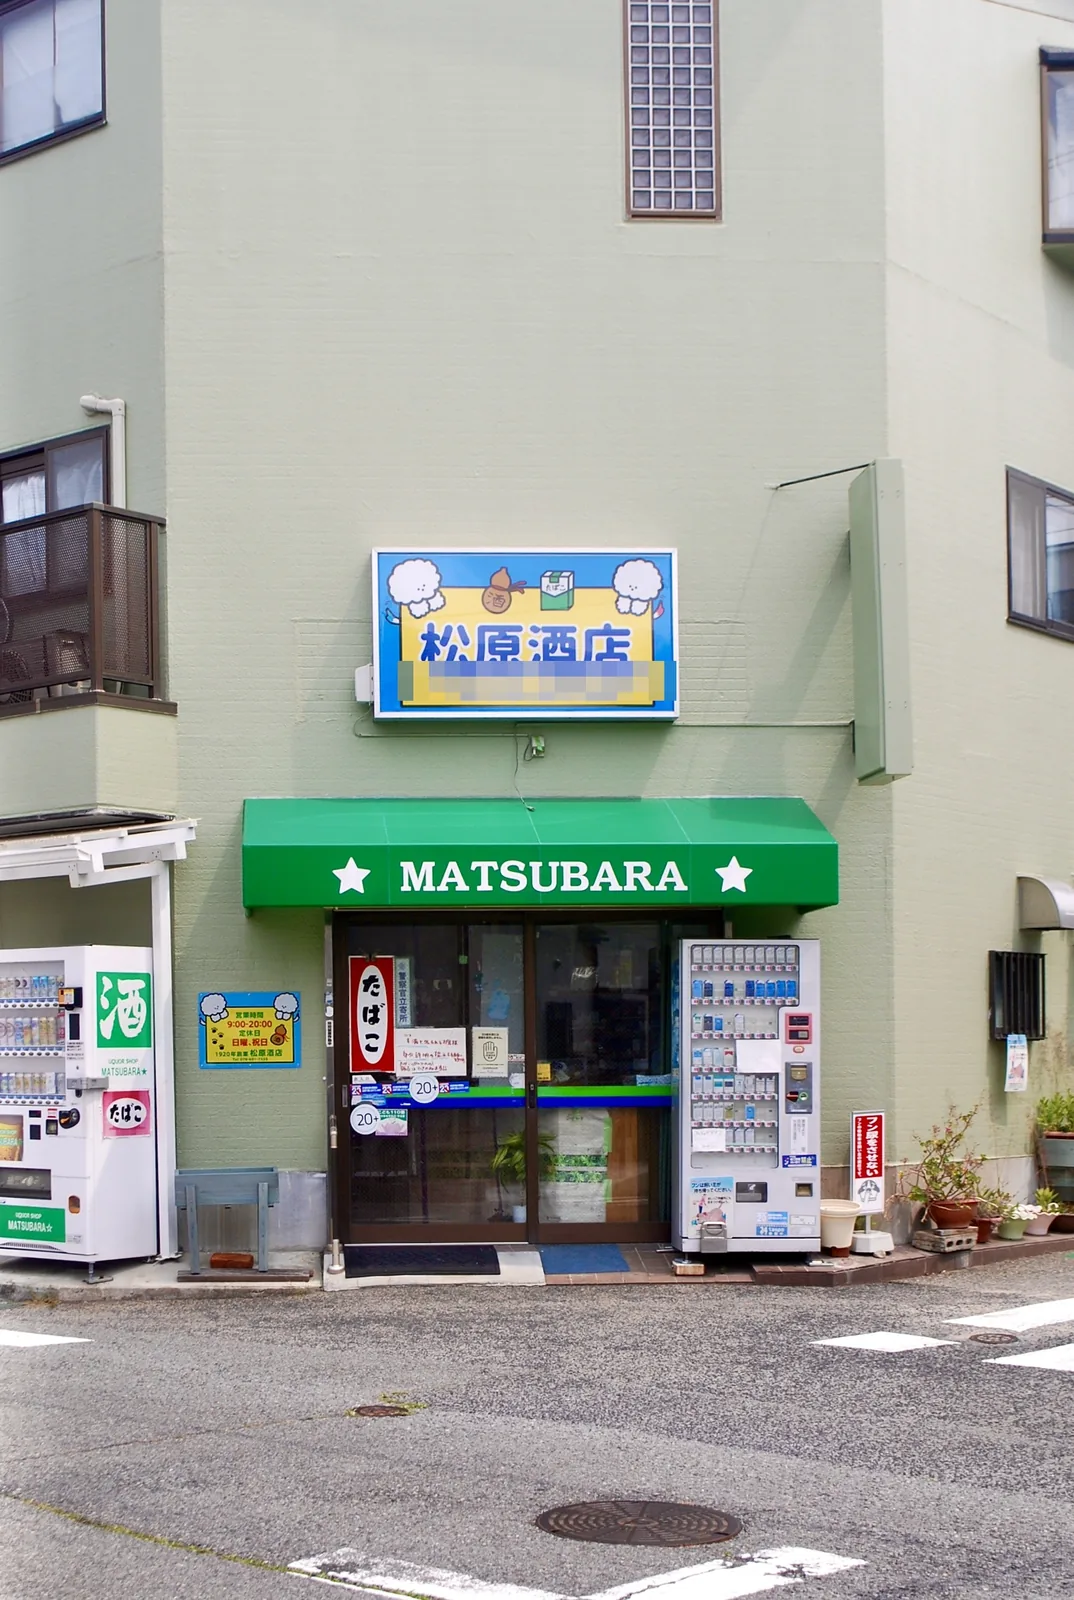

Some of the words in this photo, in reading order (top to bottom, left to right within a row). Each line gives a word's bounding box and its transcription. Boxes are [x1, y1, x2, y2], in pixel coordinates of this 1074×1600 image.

[420, 622, 632, 662] 松原酒店
[400, 860, 689, 893] MATSUBARA
[398, 971, 409, 1023] 警察官立寄所
[99, 975, 147, 1040] 酒
[362, 974, 386, 1053] たばこ
[227, 1020, 273, 1028] 9:00-20:00
[239, 1029, 261, 1037] 定休日
[101, 1067, 141, 1076] MATSUBARA
[415, 1081, 438, 1095] 20+
[109, 1102, 142, 1123] たばこ
[356, 1113, 379, 1126] 20+
[30, 1212, 42, 1220] SHOP
[8, 1219, 46, 1233] MATSUBARA
